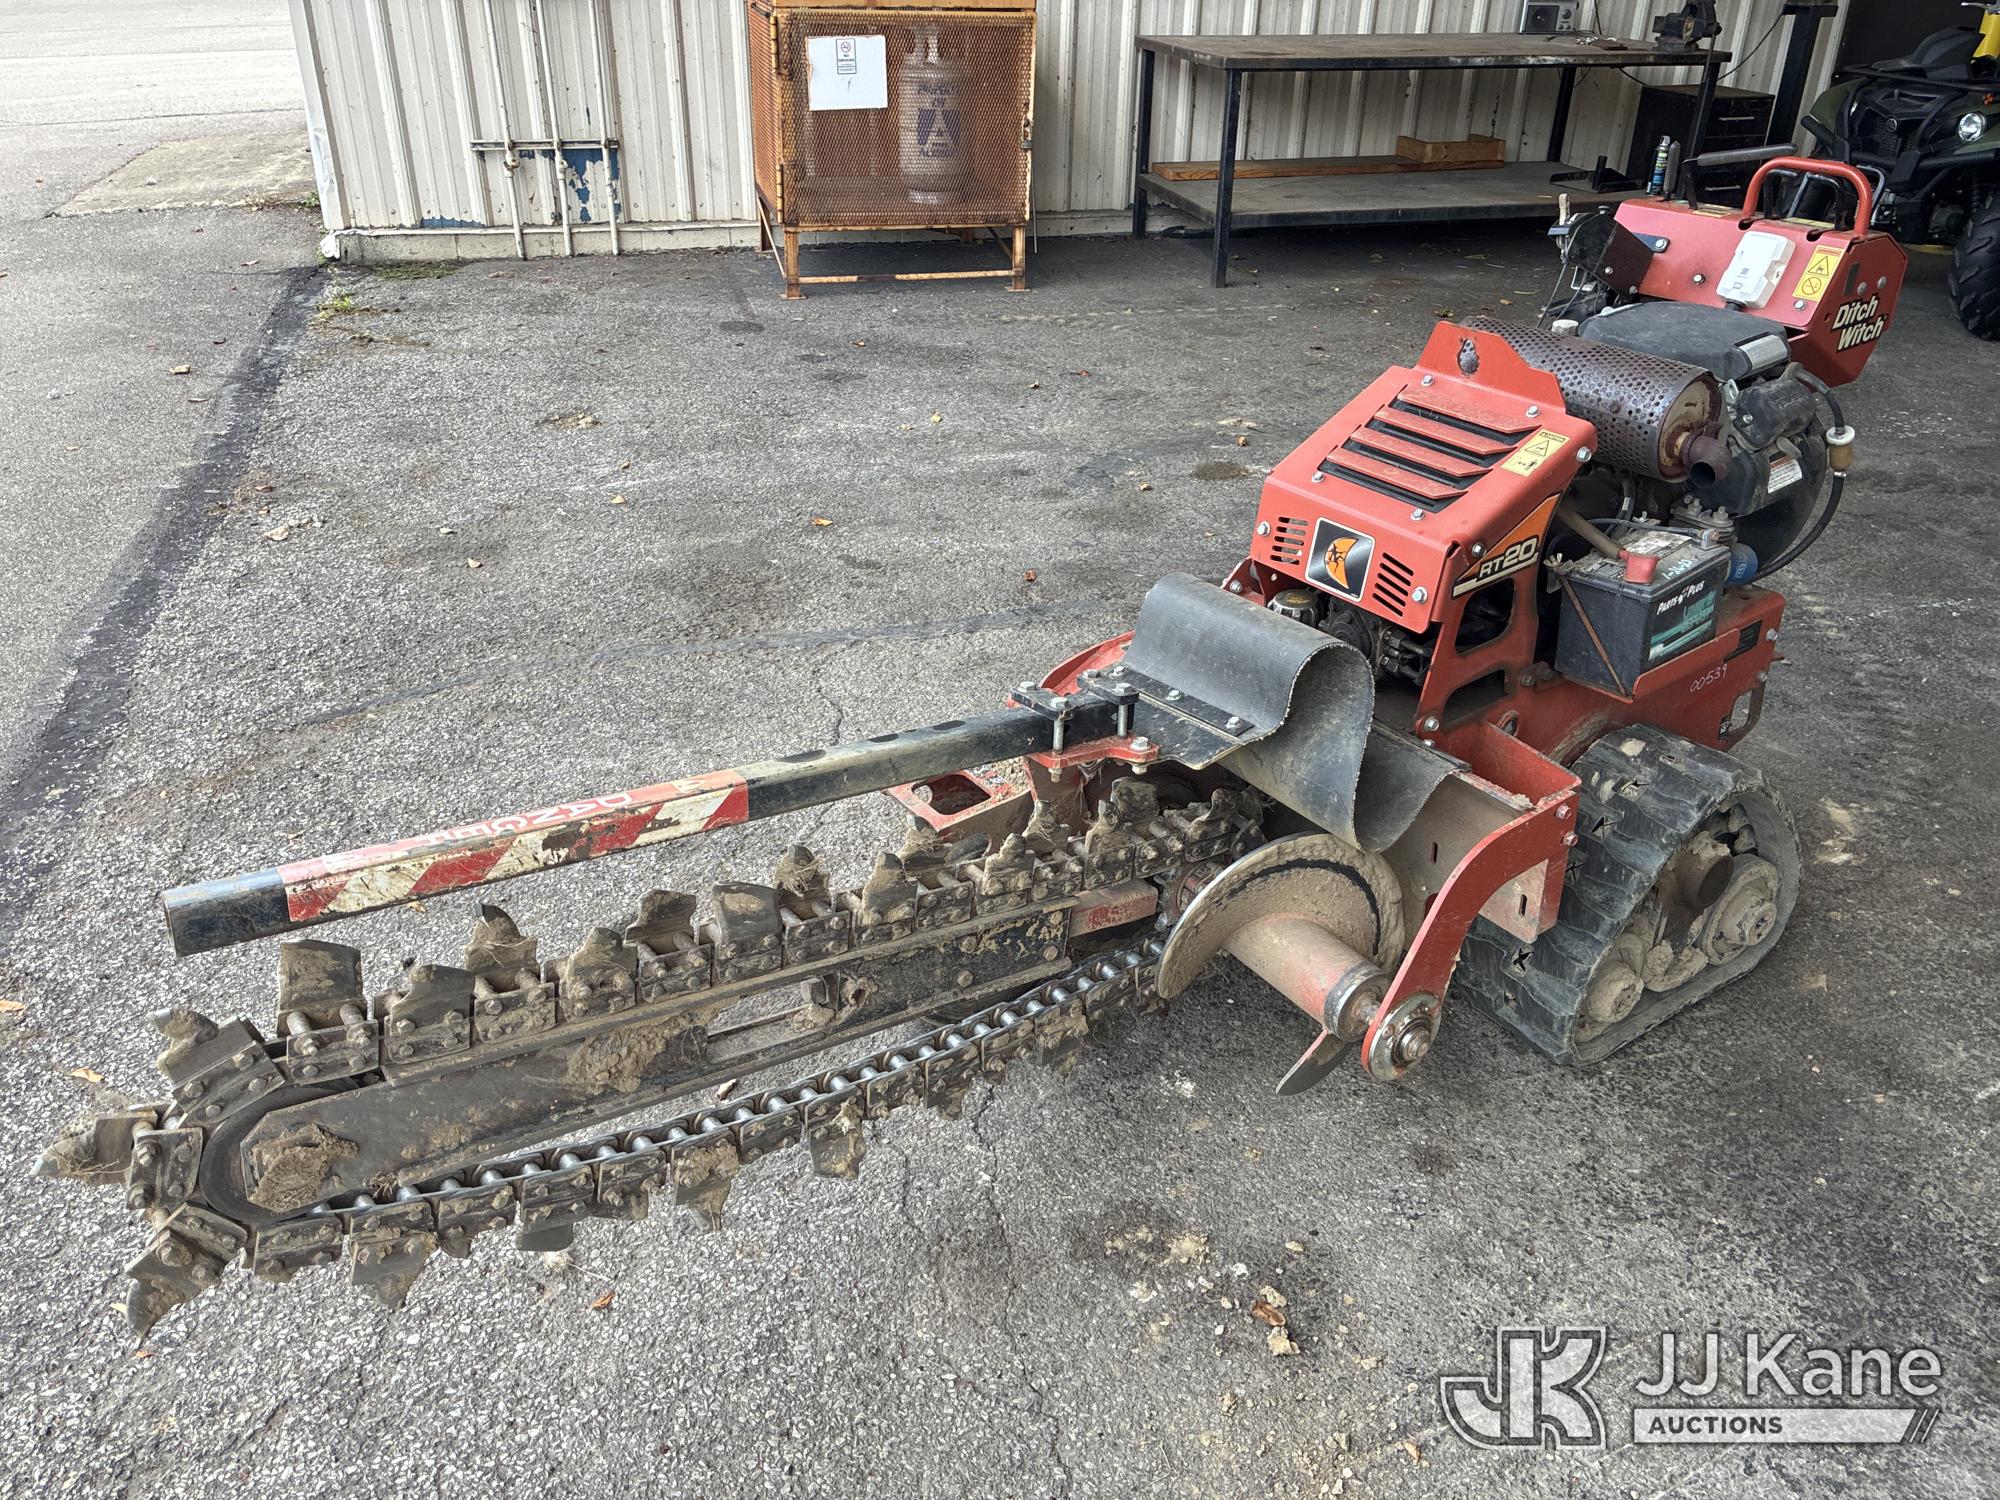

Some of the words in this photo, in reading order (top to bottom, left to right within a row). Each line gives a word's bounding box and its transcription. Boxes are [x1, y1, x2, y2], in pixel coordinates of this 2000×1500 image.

[1832, 295, 1879, 330] Ditch
[1837, 316, 1885, 351] Witch
[1479, 537, 1538, 578] RT20
